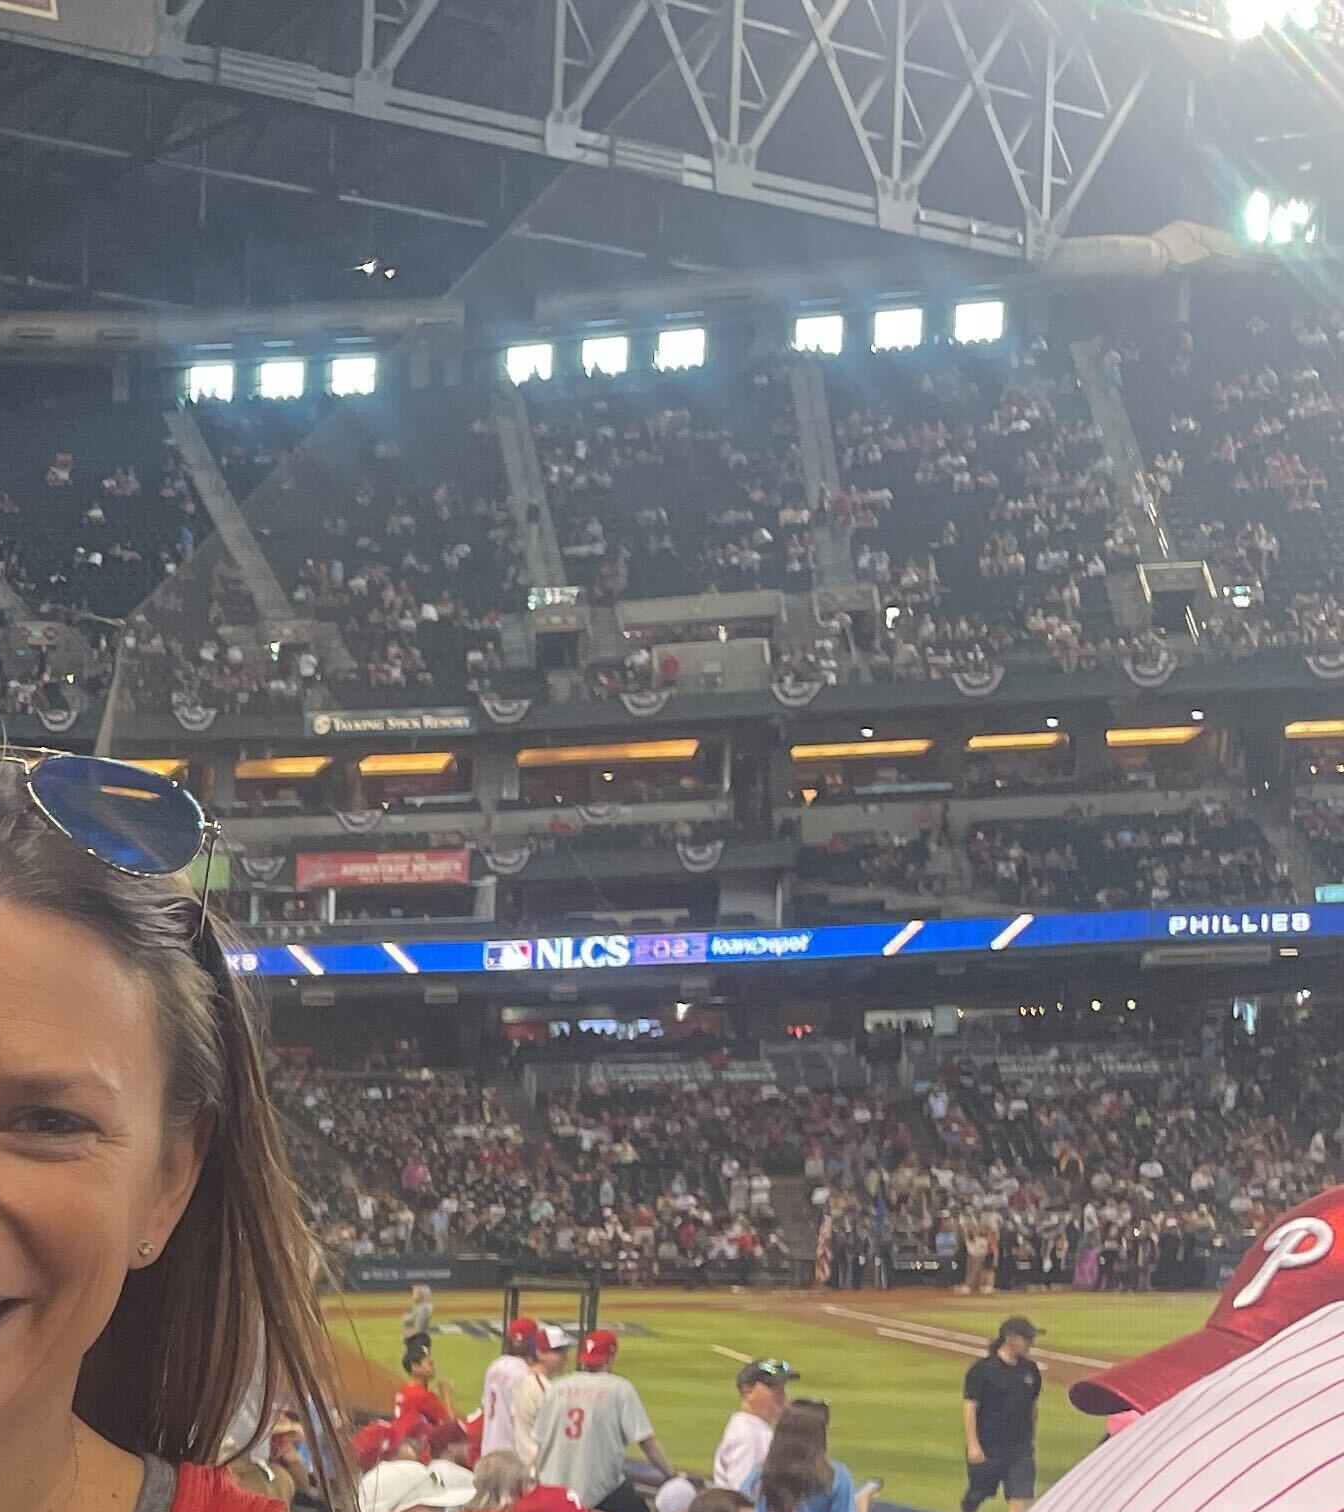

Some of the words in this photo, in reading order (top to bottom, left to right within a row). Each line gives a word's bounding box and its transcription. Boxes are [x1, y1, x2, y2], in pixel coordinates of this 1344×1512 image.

[1168, 912, 1311, 936] PHILLIES
[536, 935, 631, 970] NLCS
[1232, 1215, 1335, 1309] P
[564, 1407, 586, 1441] 3
